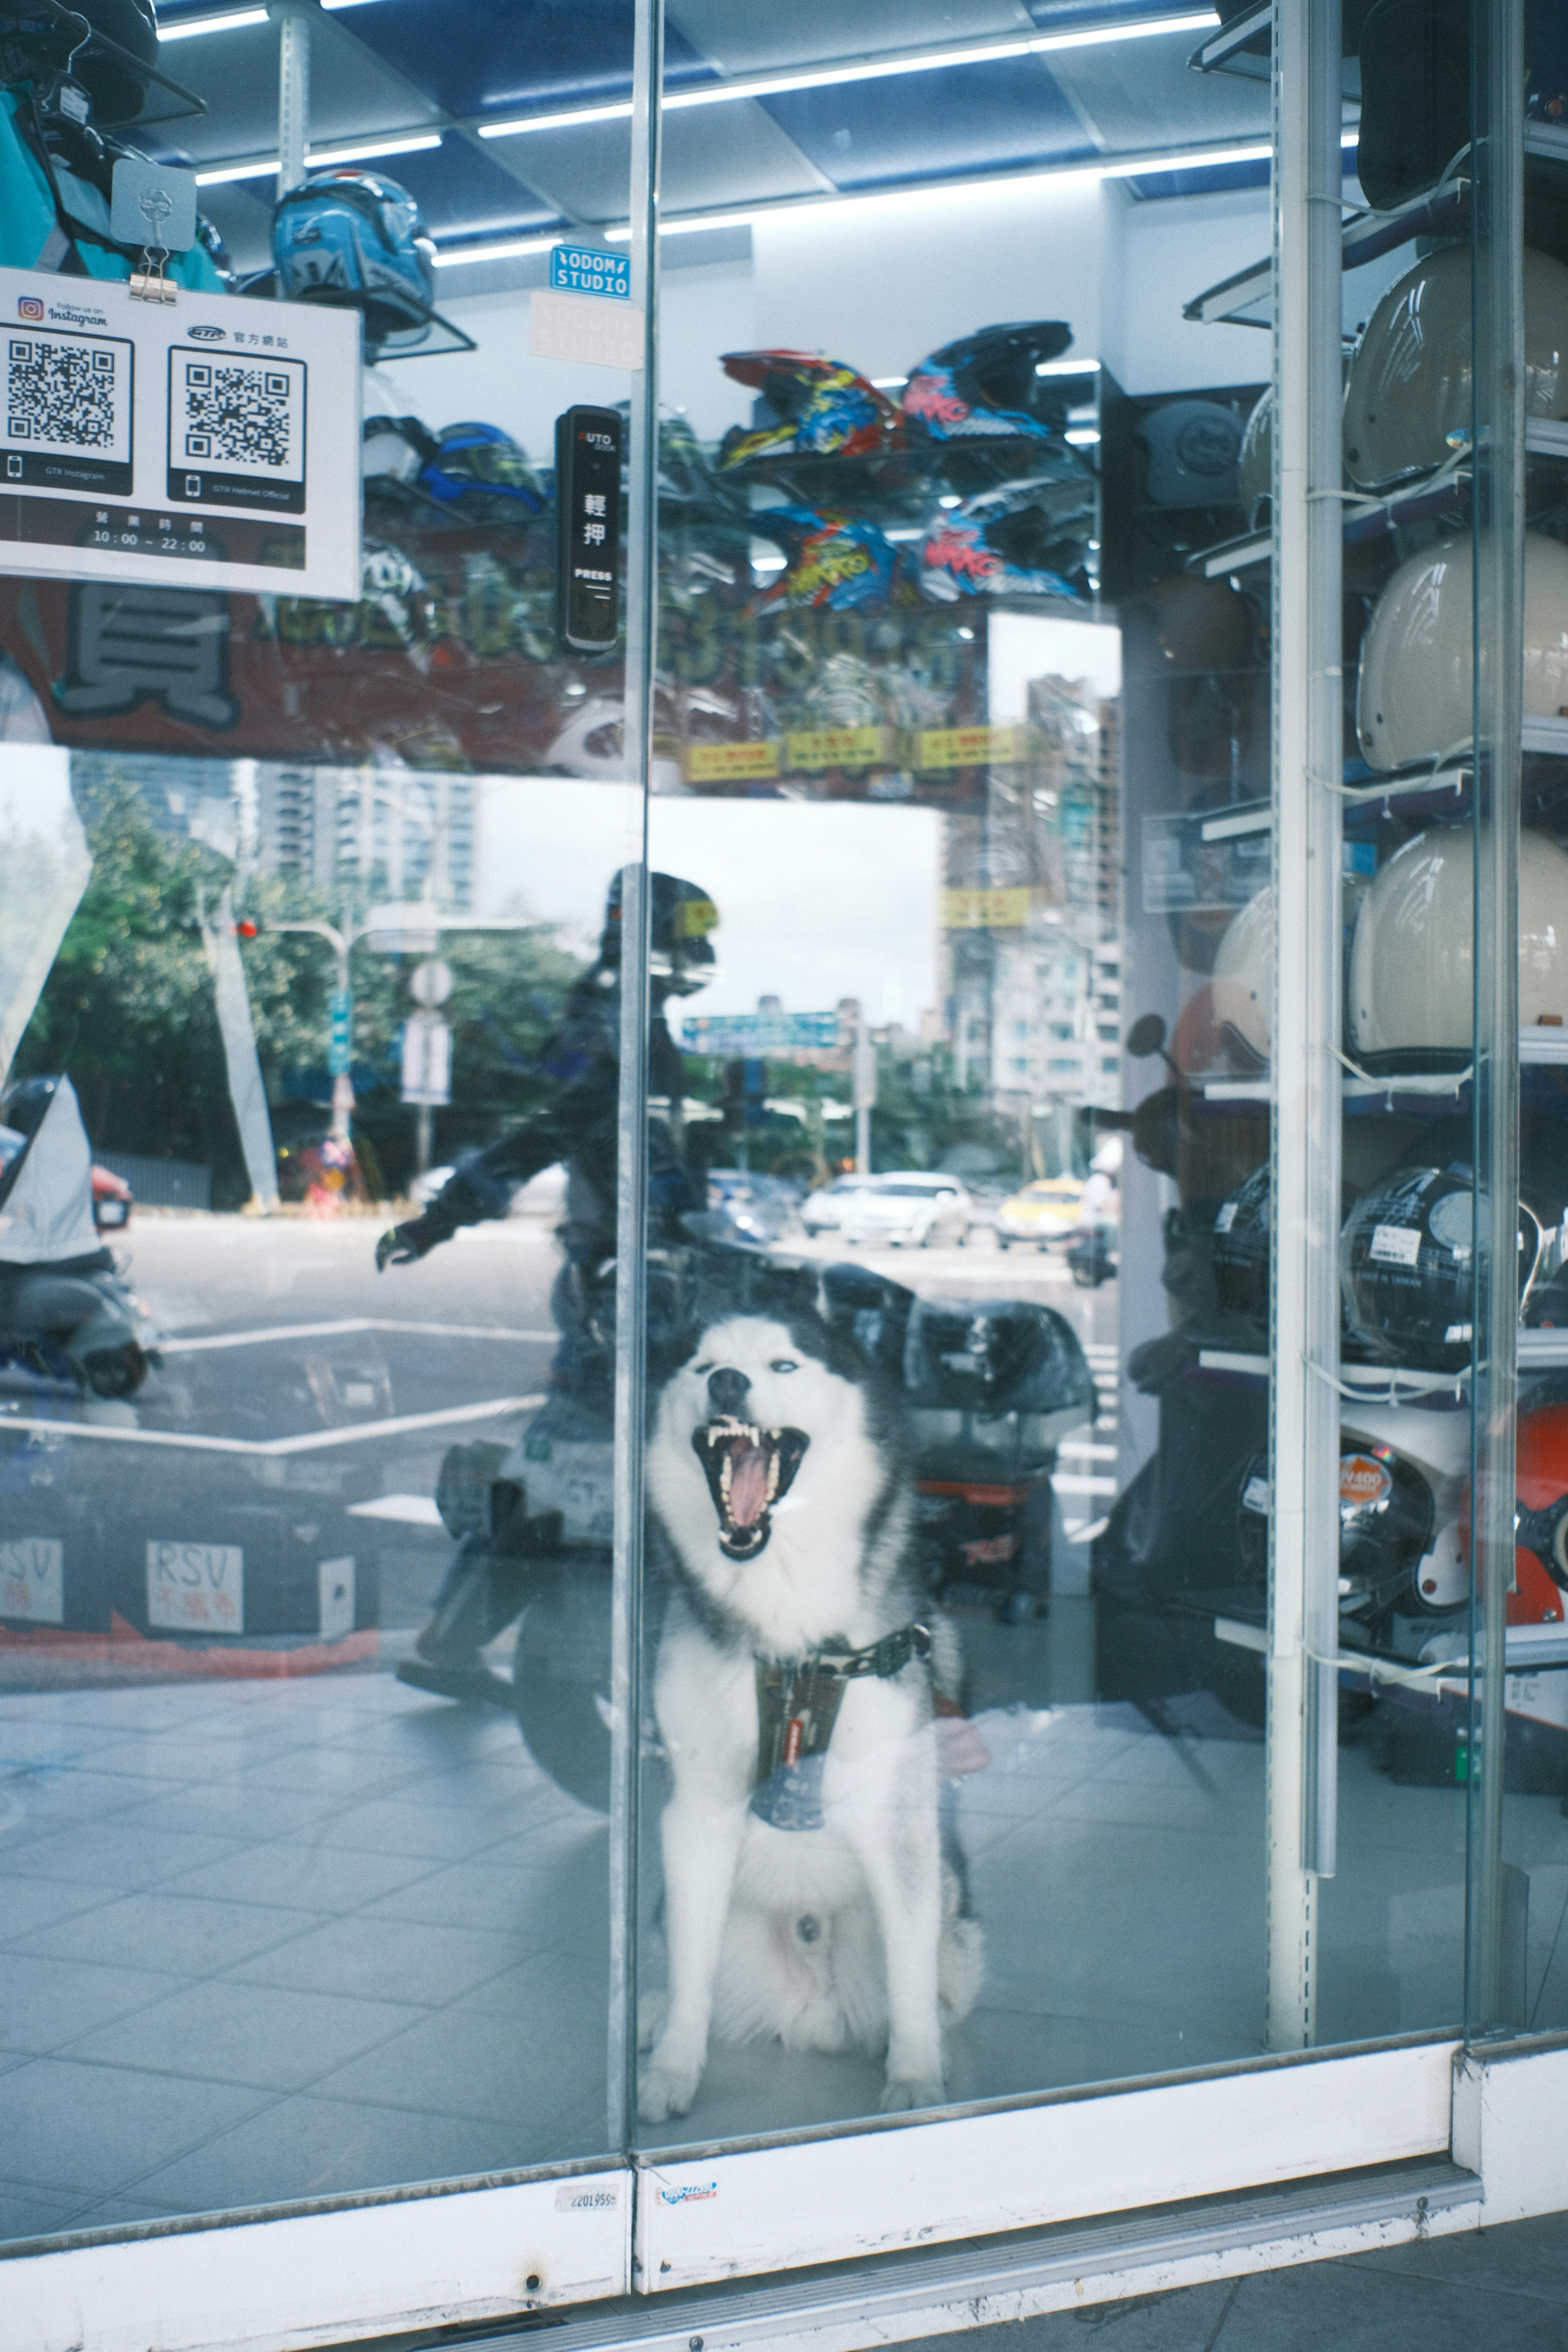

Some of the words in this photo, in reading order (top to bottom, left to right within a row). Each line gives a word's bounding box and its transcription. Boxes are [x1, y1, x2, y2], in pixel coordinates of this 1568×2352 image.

[569, 252, 616, 274] ODOM
[557, 269, 627, 294] STUDIO
[56, 302, 81, 311] Follow
[48, 307, 107, 327] Instagram
[234, 332, 288, 348] 官方網站
[577, 431, 612, 445] AUTO
[45, 467, 63, 476] GTR
[64, 470, 105, 481] Instagram
[584, 494, 606, 546] 輕押
[575, 568, 612, 581] PRESS
[0, 1544, 52, 1581] SV
[158, 1539, 228, 1588] RSV
